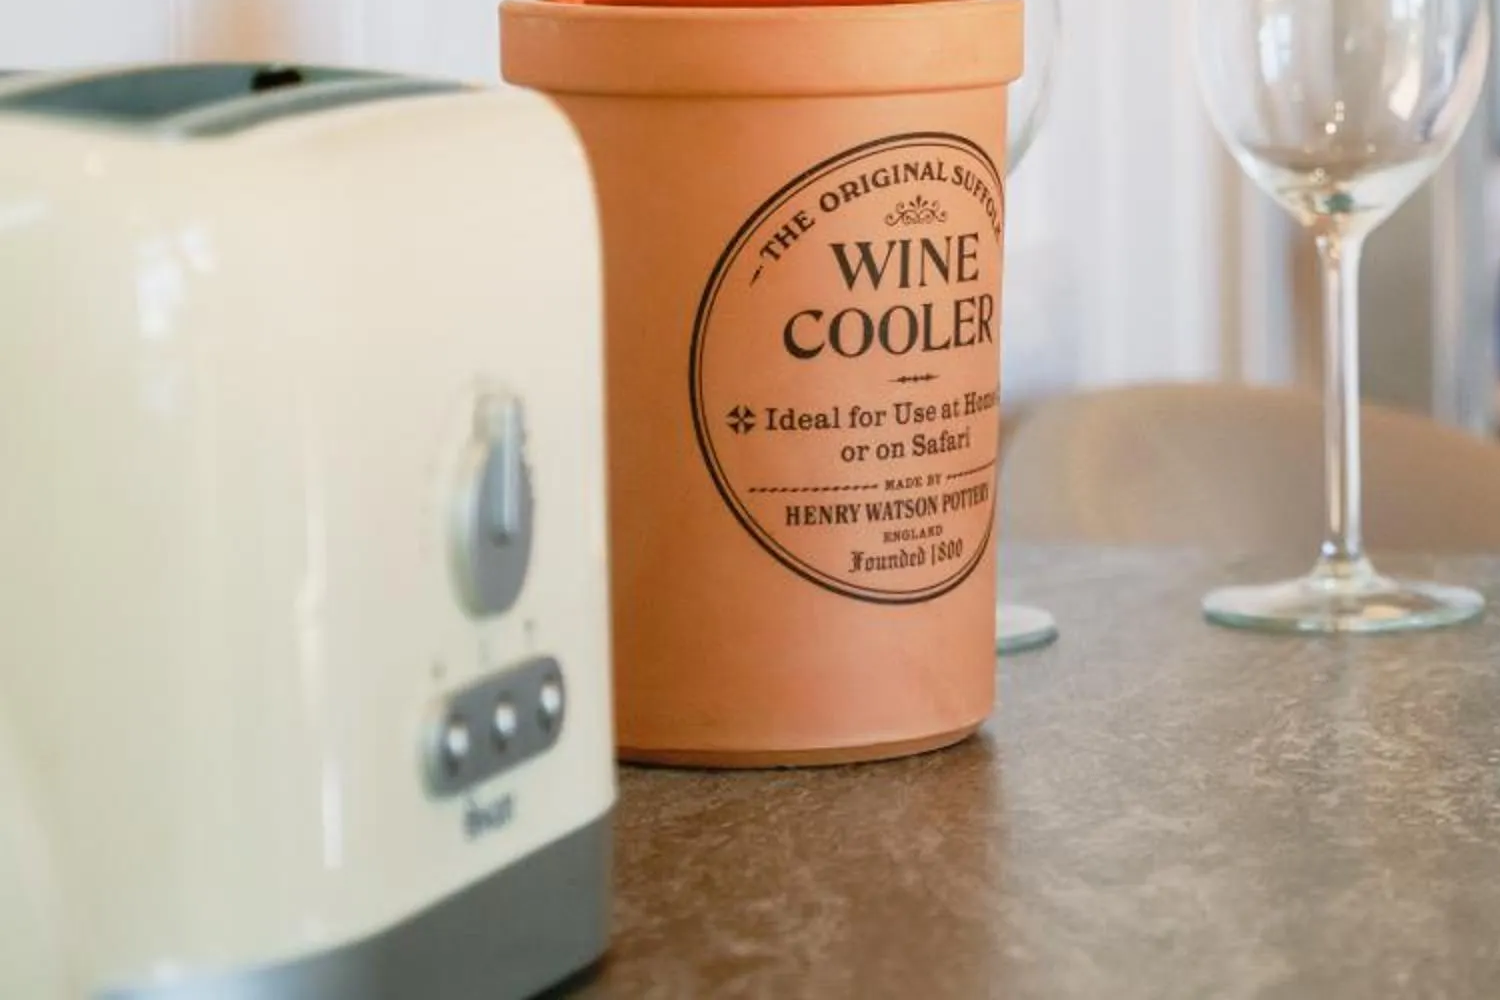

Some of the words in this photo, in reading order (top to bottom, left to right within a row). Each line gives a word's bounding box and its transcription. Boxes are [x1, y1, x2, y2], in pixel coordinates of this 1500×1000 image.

[760, 210, 815, 262] THE
[819, 161, 949, 213] ORIGINAL
[828, 232, 980, 291] WINE
[783, 293, 994, 360] COOLER
[765, 406, 841, 432] Ideal
[848, 405, 887, 430] for
[894, 402, 936, 426] Use
[941, 399, 960, 419] at
[841, 444, 870, 463] or
[876, 442, 905, 461] on
[911, 425, 971, 457] Safari
[884, 476, 923, 492] MADE
[927, 473, 942, 487] BY
[785, 504, 862, 527] HENRY
[865, 495, 939, 522] WATSON
[883, 525, 943, 543] ENGLAND
[848, 546, 926, 573] Founded
[931, 537, 963, 567] 1800
